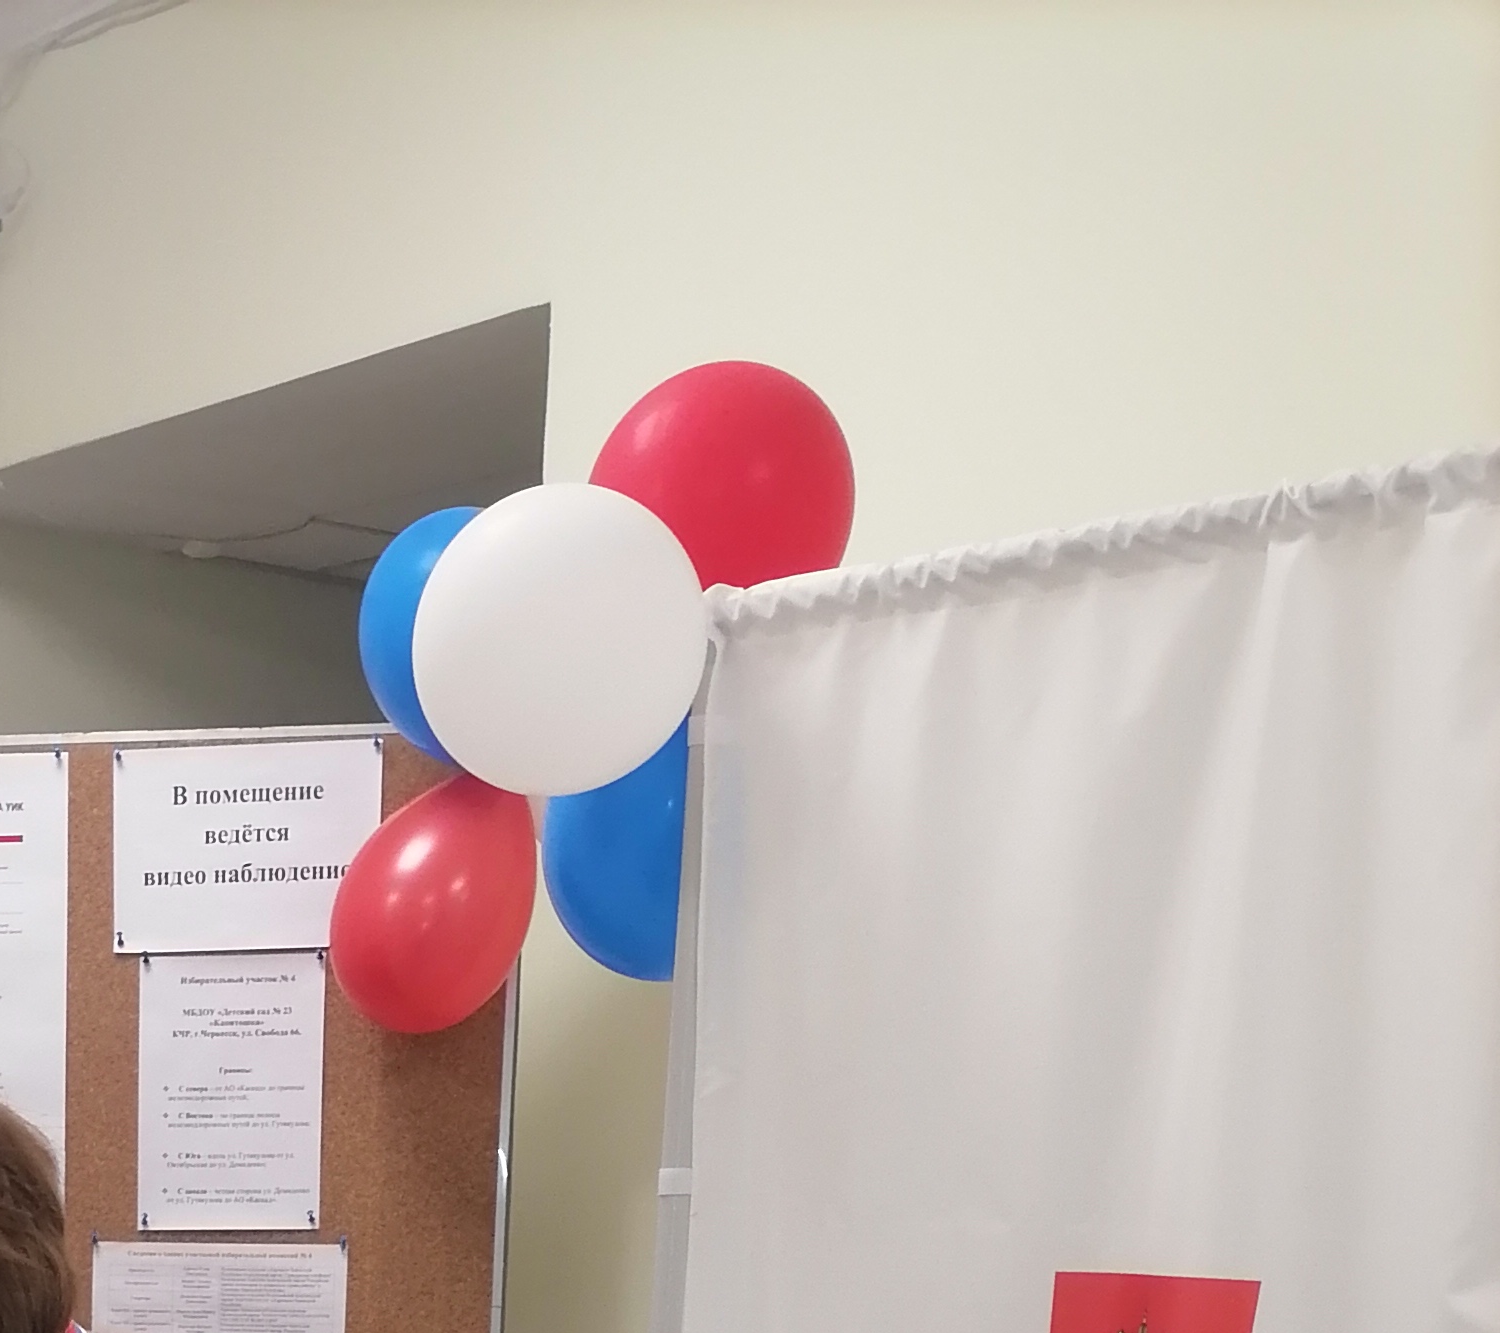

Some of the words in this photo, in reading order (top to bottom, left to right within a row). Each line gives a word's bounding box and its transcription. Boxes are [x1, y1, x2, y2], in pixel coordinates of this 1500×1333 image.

[172, 785, 188, 806] В
[195, 784, 325, 805] помещение
[5, 802, 24, 812] УИК
[204, 824, 290, 846] ведётся
[143, 867, 207, 887] видео
